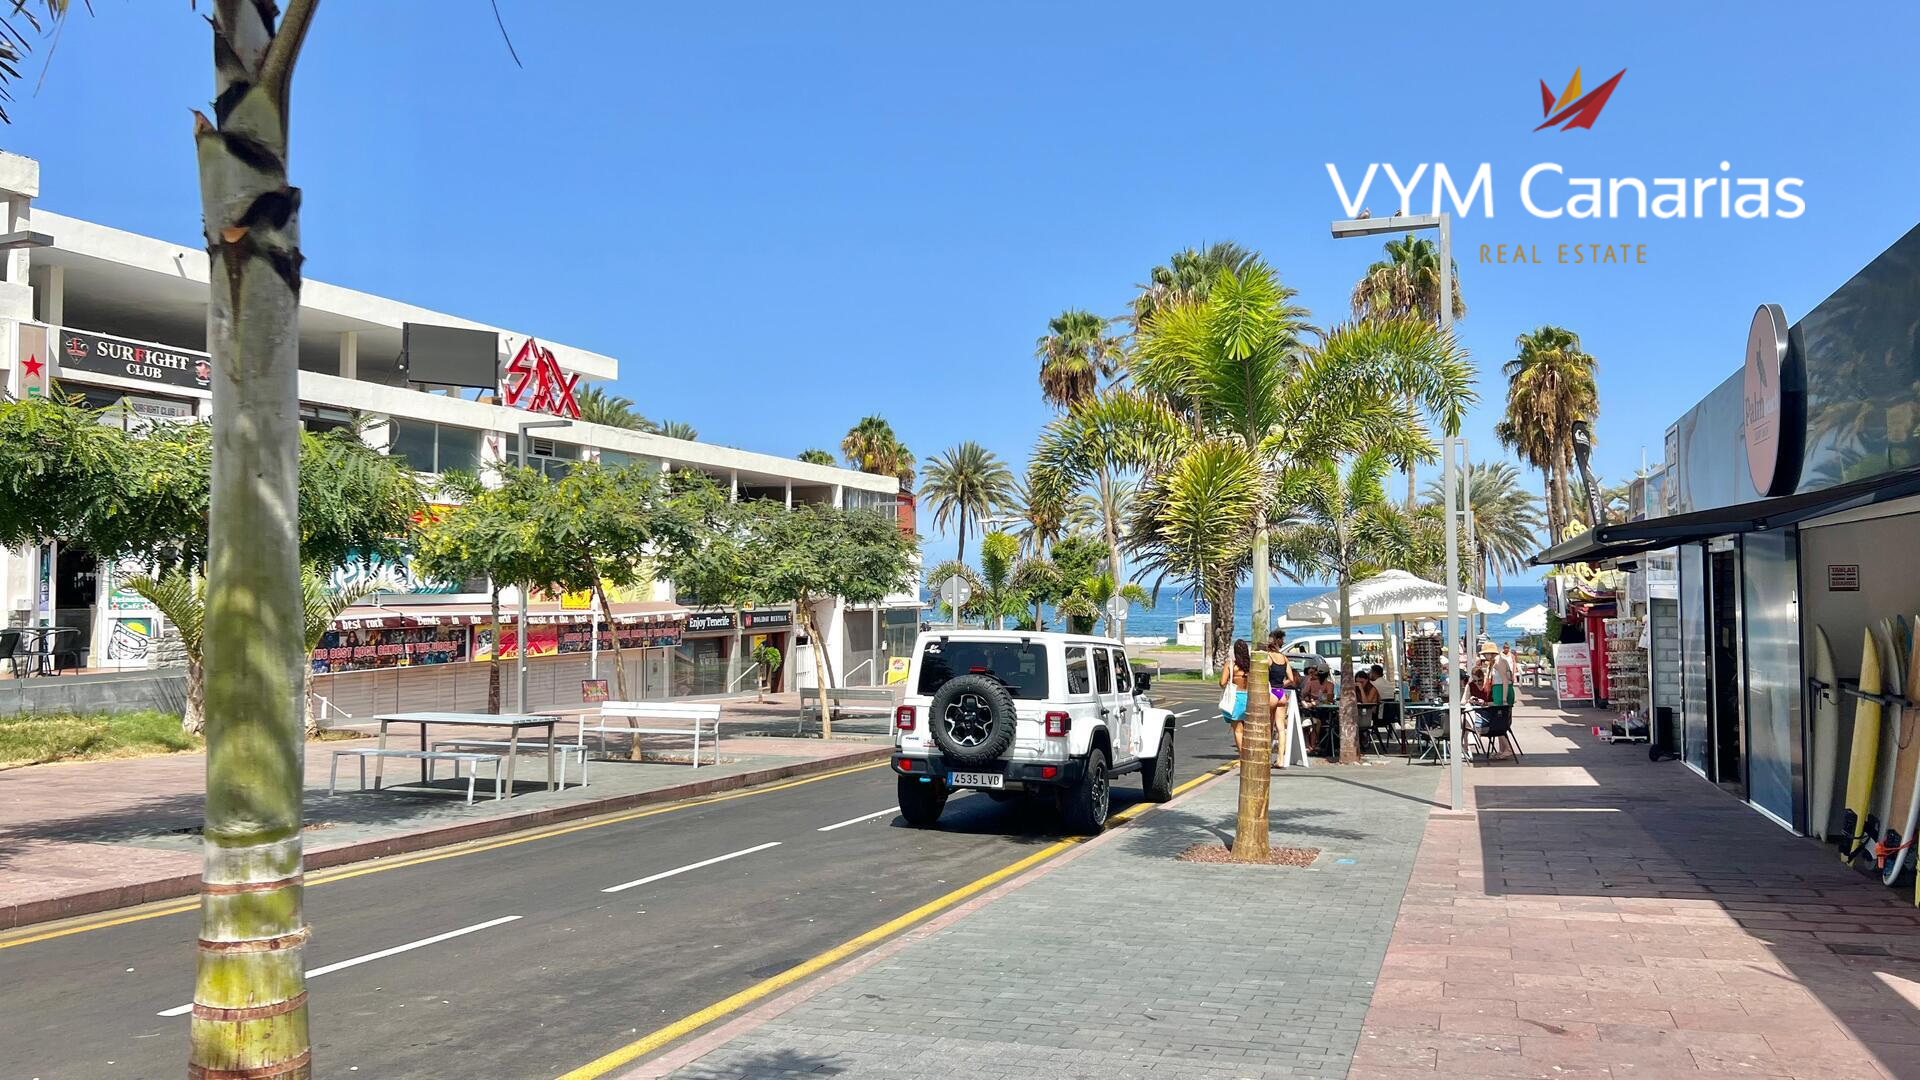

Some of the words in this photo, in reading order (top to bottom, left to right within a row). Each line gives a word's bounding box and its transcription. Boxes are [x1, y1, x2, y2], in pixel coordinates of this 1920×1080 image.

[97, 341, 189, 370] SURFIGHT
[126, 363, 162, 379] CLUB
[690, 616, 707, 630] Enjoy
[707, 615, 731, 628] Tenerife
[353, 645, 377, 657] ROCK
[377, 643, 404, 655] BANDS
[954, 774, 978, 784] 4535
[981, 775, 999, 785] LVD
